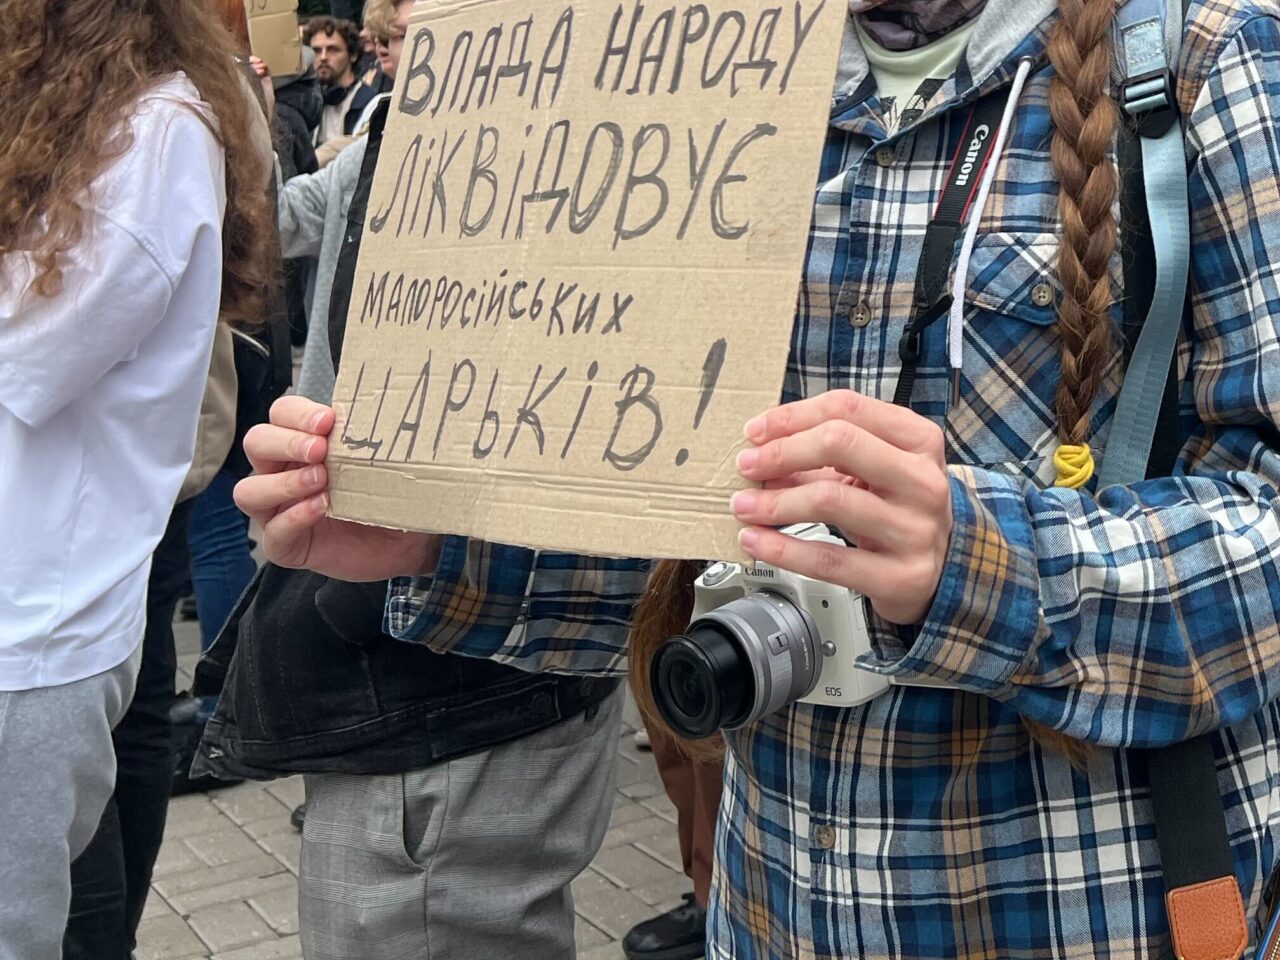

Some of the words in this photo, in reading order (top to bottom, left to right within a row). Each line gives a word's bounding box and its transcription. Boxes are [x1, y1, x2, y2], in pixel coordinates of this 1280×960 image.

[399, 6, 574, 118] ВЛАДА
[594, 0, 827, 98] НАРОДУ
[955, 123, 990, 187] Canon
[745, 566, 774, 578] Canon
[825, 686, 842, 697] EOS
